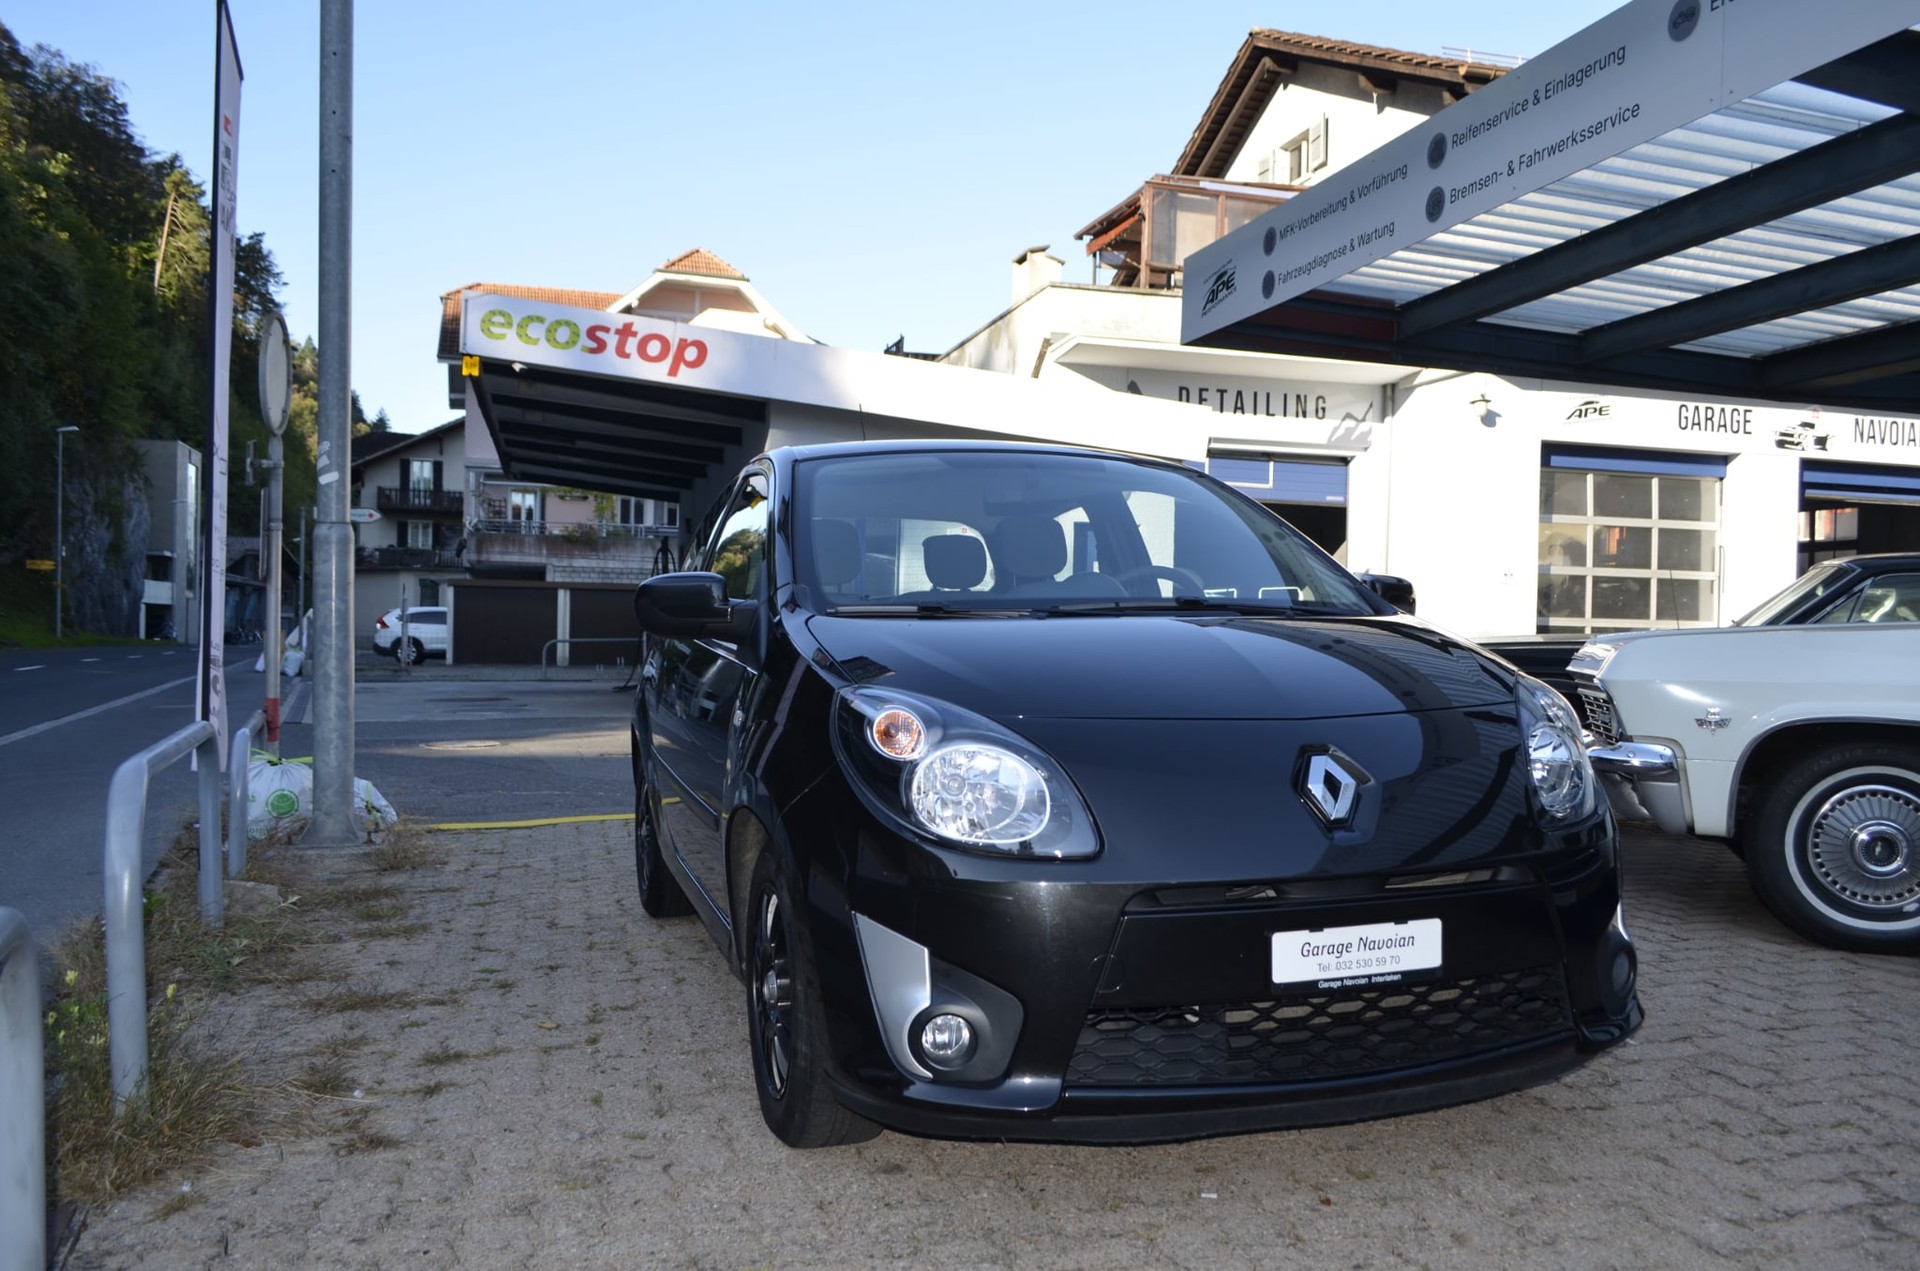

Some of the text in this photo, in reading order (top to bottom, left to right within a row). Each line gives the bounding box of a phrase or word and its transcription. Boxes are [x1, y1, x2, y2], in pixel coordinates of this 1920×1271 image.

[1451, 45, 1626, 149] Reifenservice & Einlagerung
[1450, 103, 1640, 204] Bremsen- & Fahrwerksservice
[1278, 164, 1407, 241] MFK-Vorbereitung & Vorführung
[1278, 221, 1395, 285] Fahrzeugdiagnose & Wartung
[1202, 270, 1236, 311] APE
[480, 308, 708, 377] ecostop
[1178, 386, 1327, 420] DETAILING
[1566, 405, 1611, 420] APE
[1678, 404, 1920, 447] GARAGE NAVOIA
[1300, 933, 1415, 958] Garage Navoian
[1317, 955, 1400, 973] Tel: 032 530 59 70
[1318, 980, 1342, 989] Garage
[1343, 977, 1369, 986] Navoian
